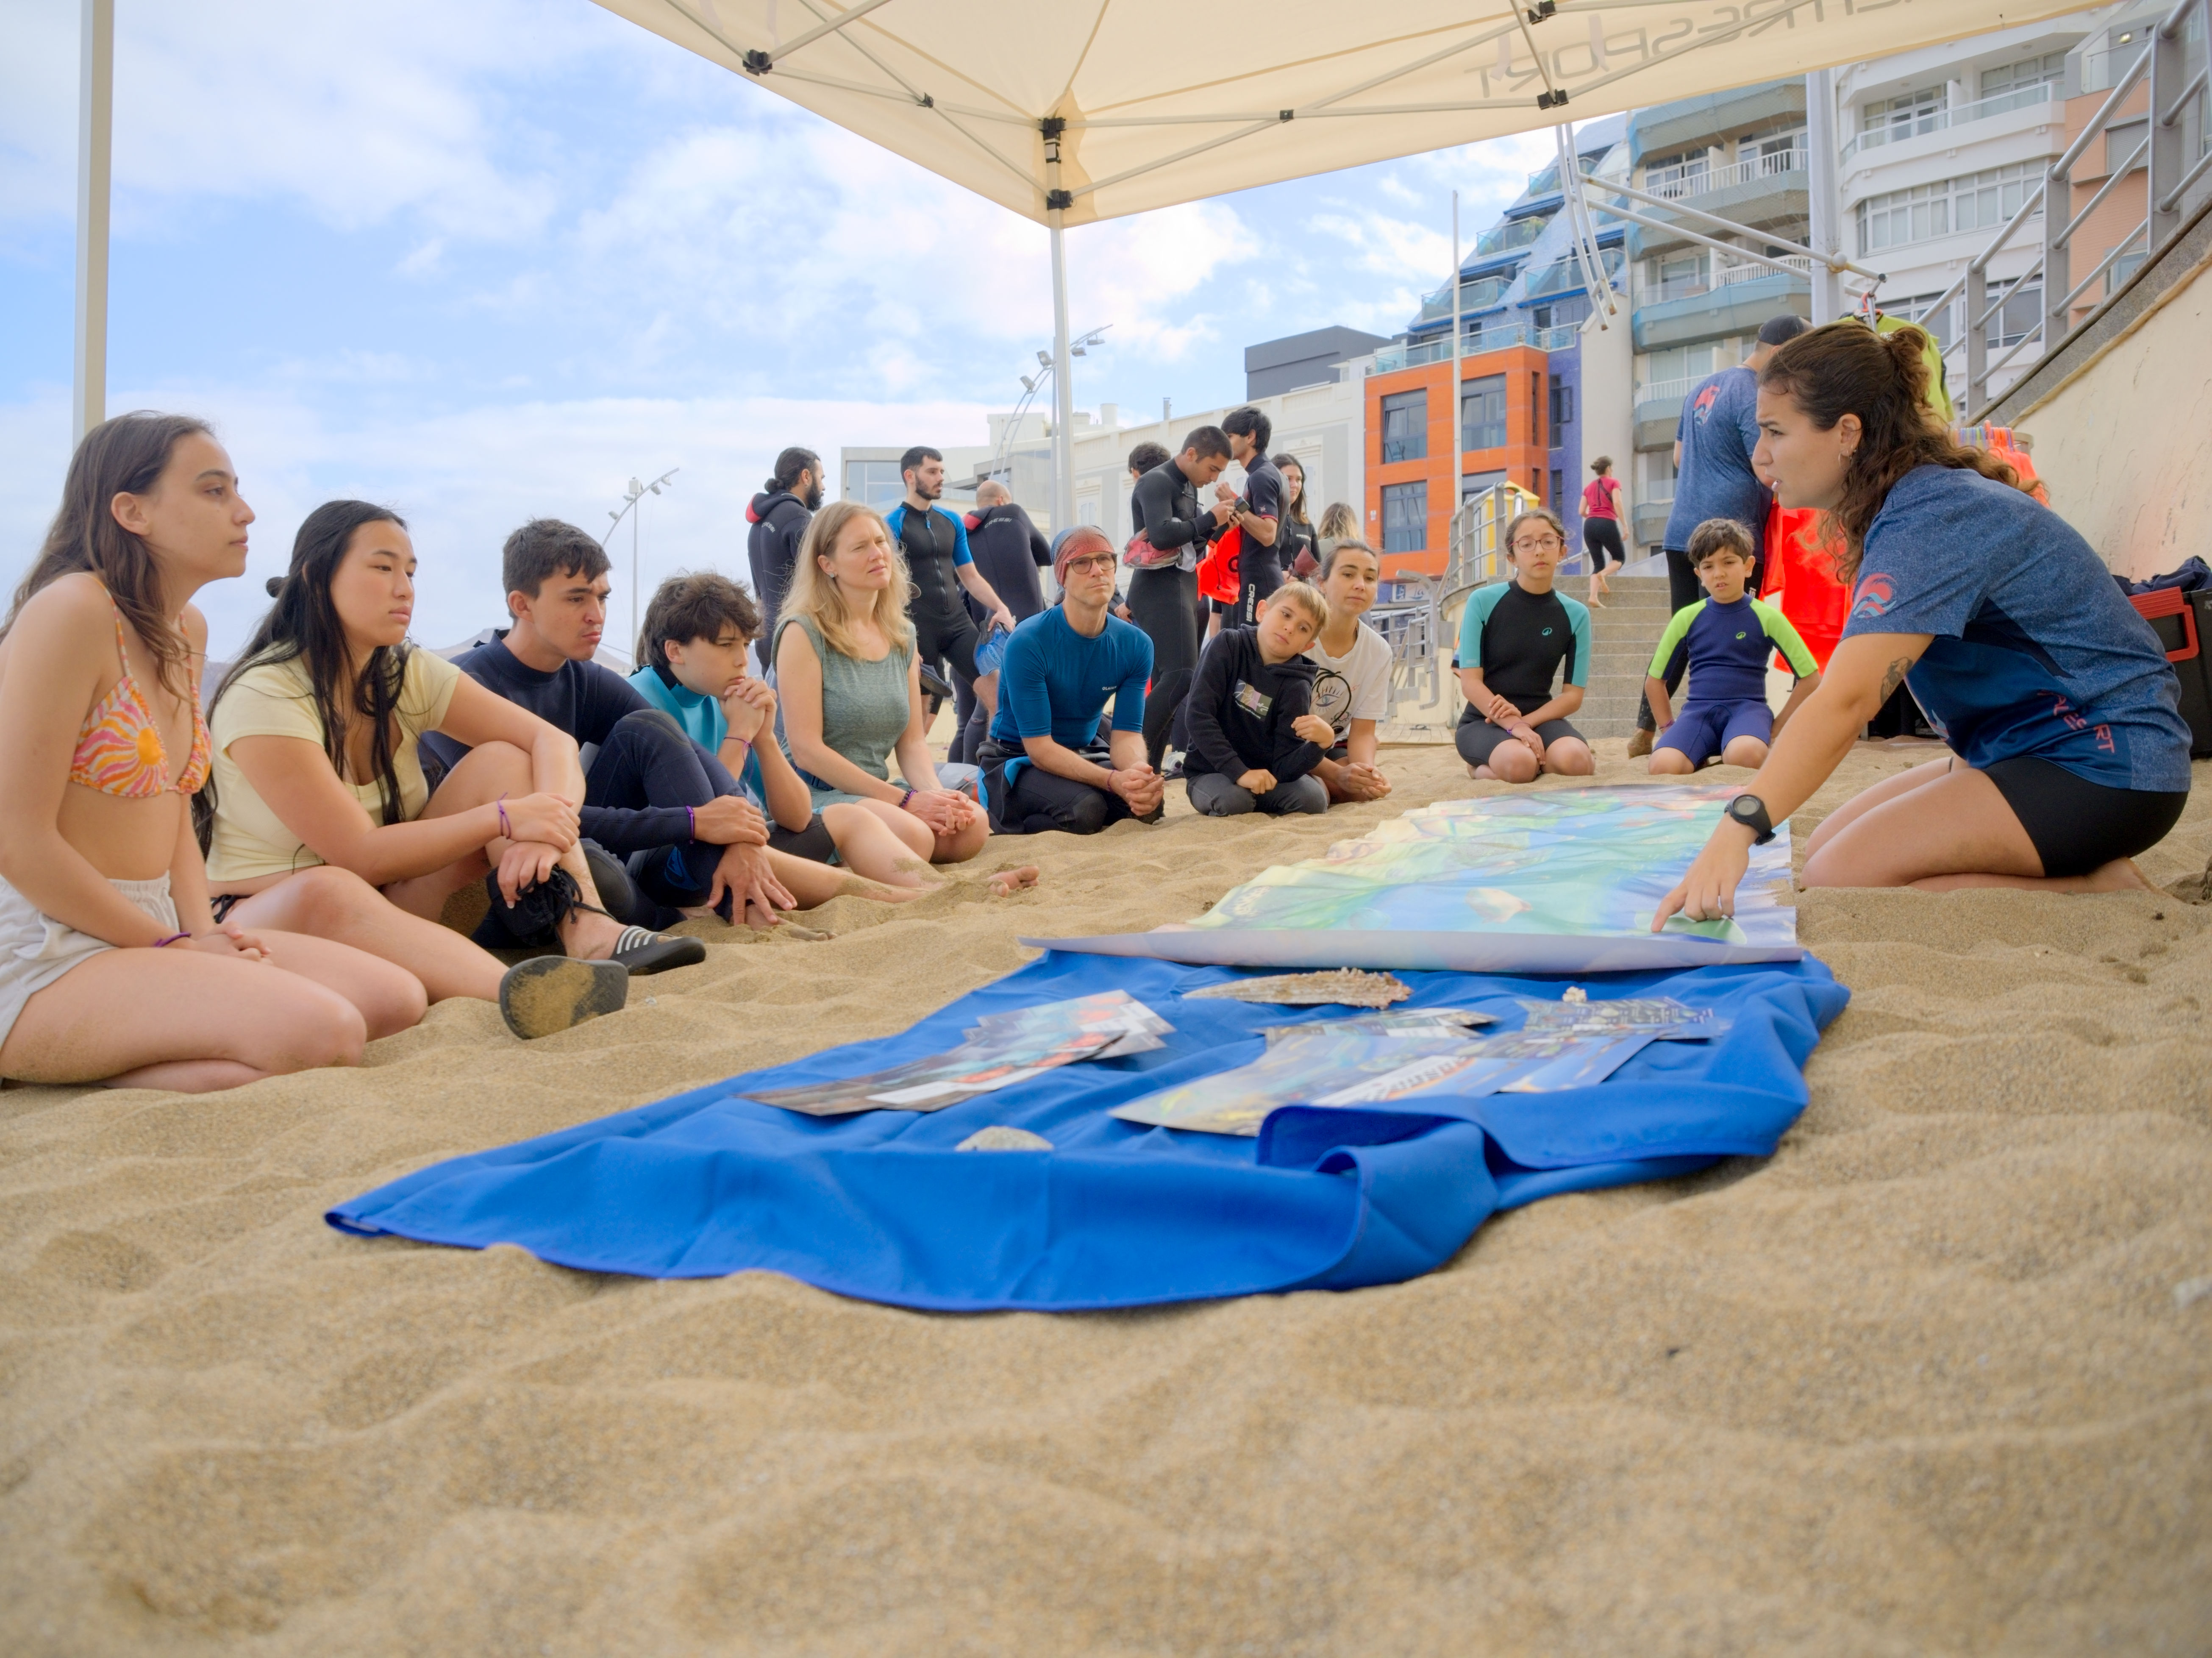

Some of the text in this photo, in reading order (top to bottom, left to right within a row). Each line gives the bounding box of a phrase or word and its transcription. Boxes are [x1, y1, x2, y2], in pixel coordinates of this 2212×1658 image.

[761, 522, 776, 533] CRESSI
[984, 517, 1012, 529] CRESSI
[1246, 583, 1256, 622] CRESSI
